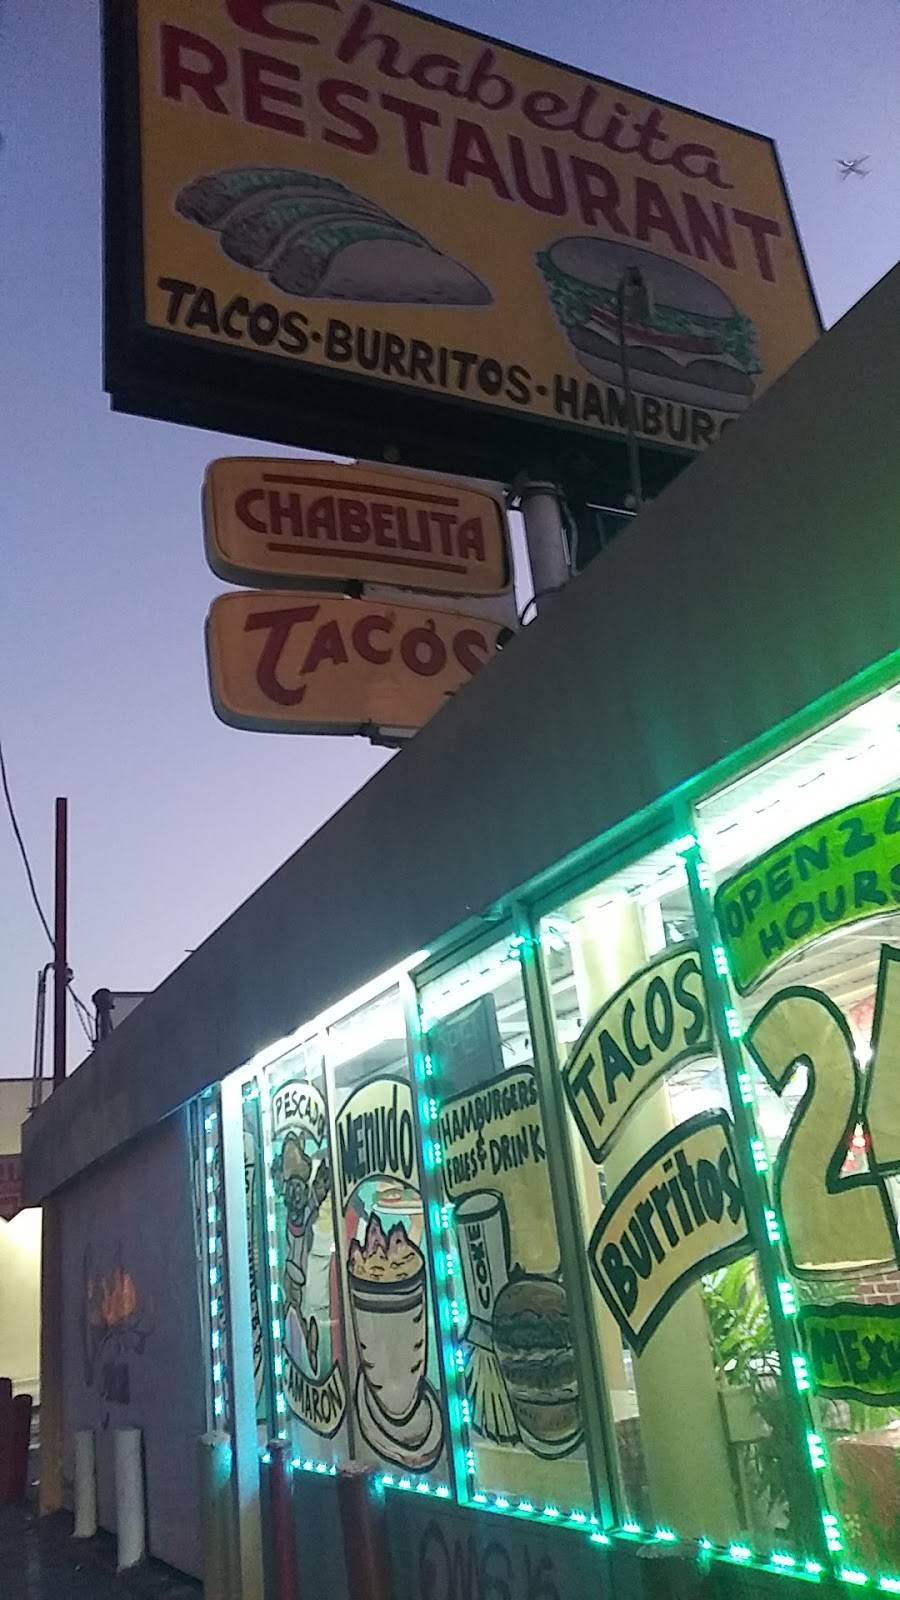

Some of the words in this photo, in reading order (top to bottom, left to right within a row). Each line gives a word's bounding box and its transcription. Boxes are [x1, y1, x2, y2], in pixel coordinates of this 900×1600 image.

[226, 0, 733, 189] Chabelita
[160, 23, 781, 283] RESTAURANT
[157, 277, 310, 356] TACOS
[325, 319, 531, 404] BURRITOS
[234, 488, 486, 562] CHABELITA
[243, 604, 489, 707] TACOS
[724, 836, 829, 939] OPEN
[570, 957, 704, 1127] TACOS
[441, 1077, 538, 1150] HAMBURGERS
